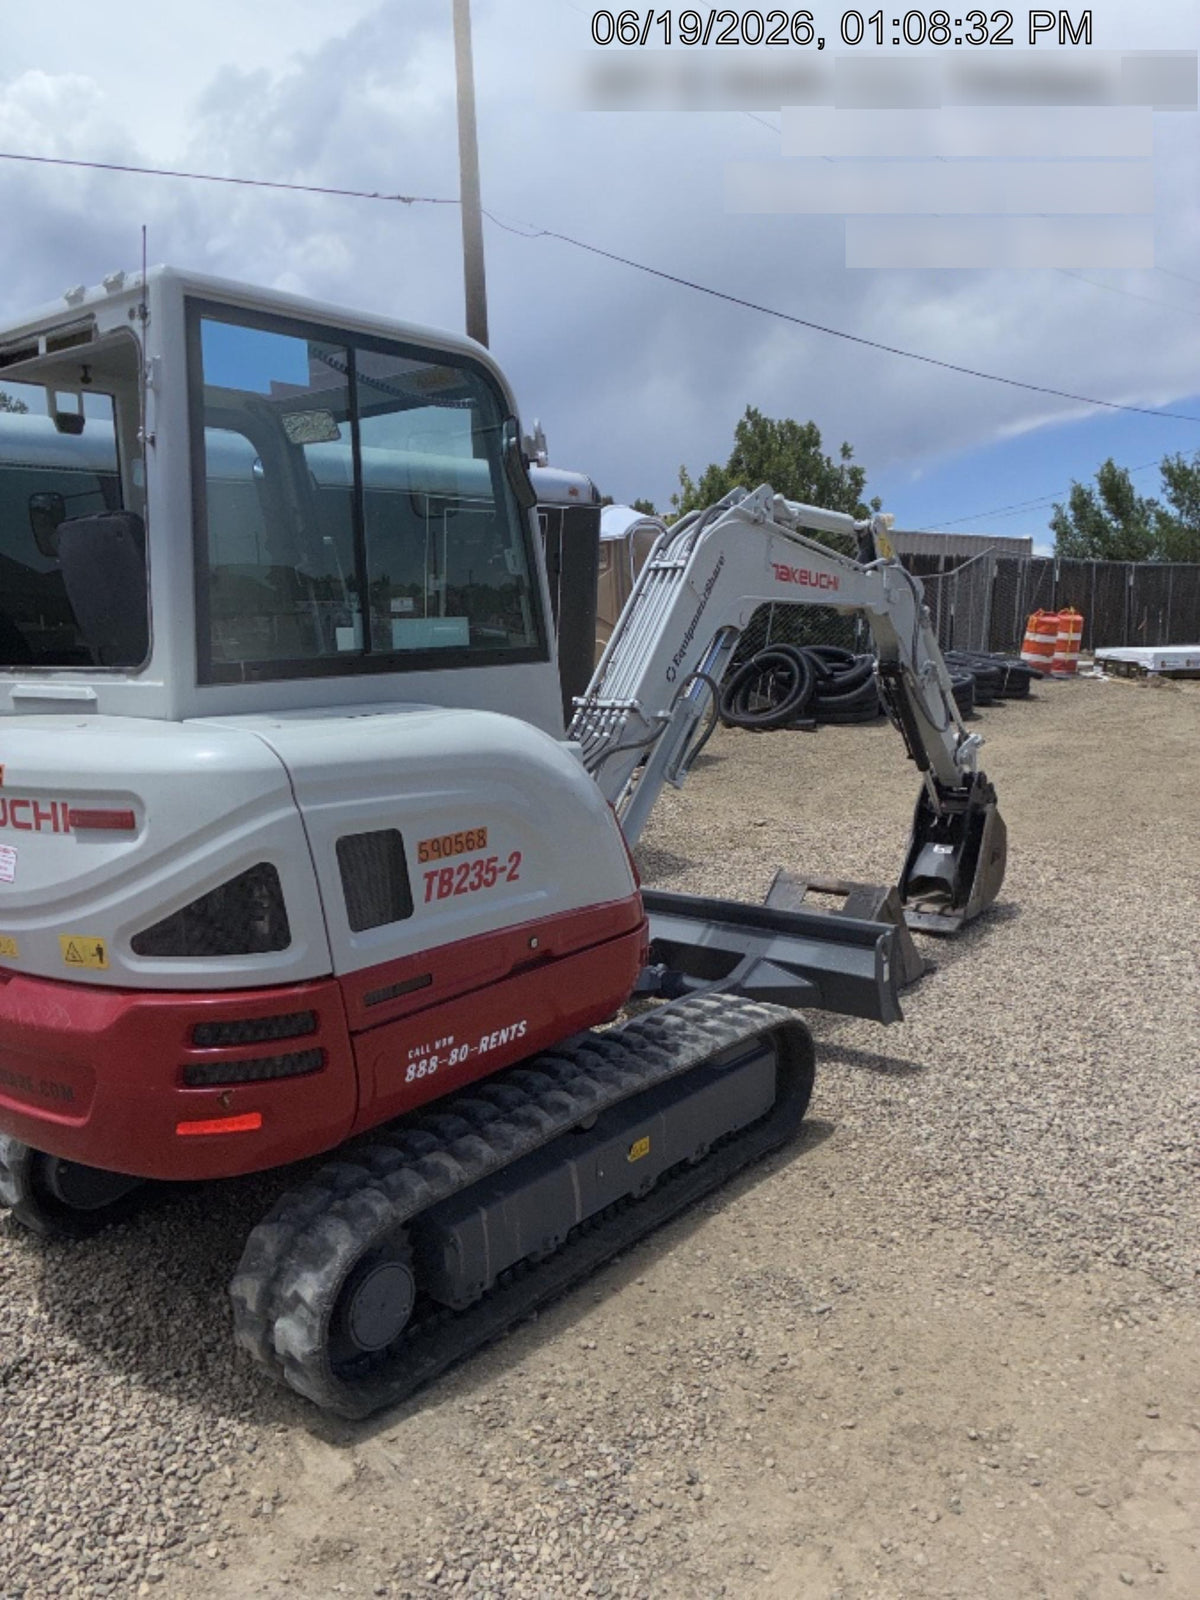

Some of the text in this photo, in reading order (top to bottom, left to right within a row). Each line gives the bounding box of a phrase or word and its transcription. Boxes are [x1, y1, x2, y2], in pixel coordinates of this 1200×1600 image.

[418, 828, 487, 863] 590568
[422, 850, 522, 904] TB235-2
[404, 1020, 528, 1083] 888-80-RENTS
[408, 1043, 431, 1060] CALL
